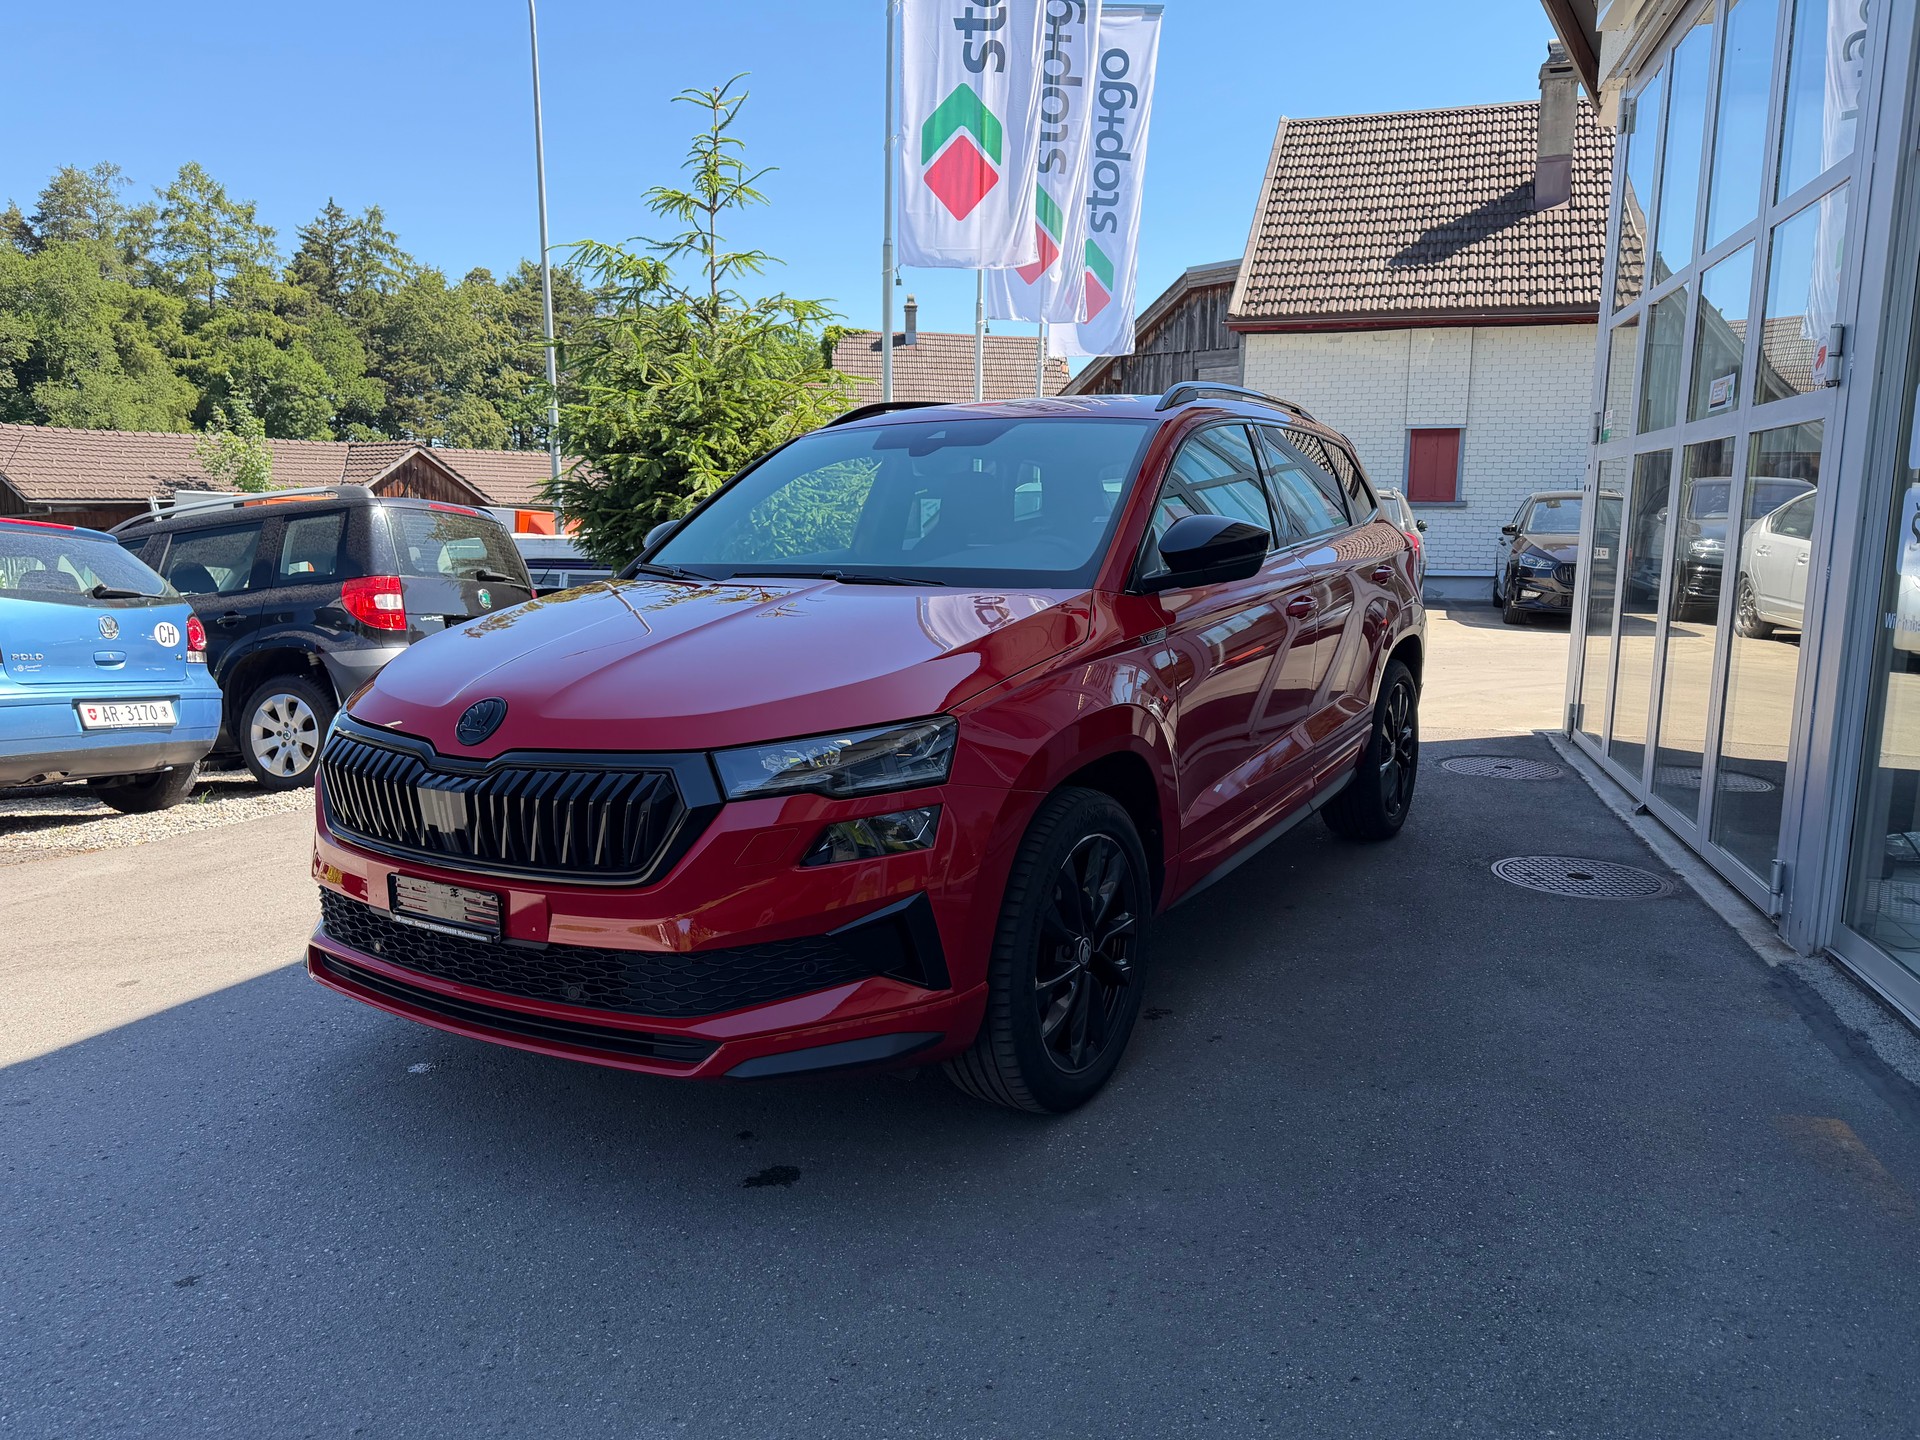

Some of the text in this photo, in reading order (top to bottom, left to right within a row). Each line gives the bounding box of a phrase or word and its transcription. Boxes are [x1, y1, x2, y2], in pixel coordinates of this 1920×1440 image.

[953, 0, 1007, 73] st
[1086, 48, 1138, 234] stop+go
[158, 624, 176, 643] CH
